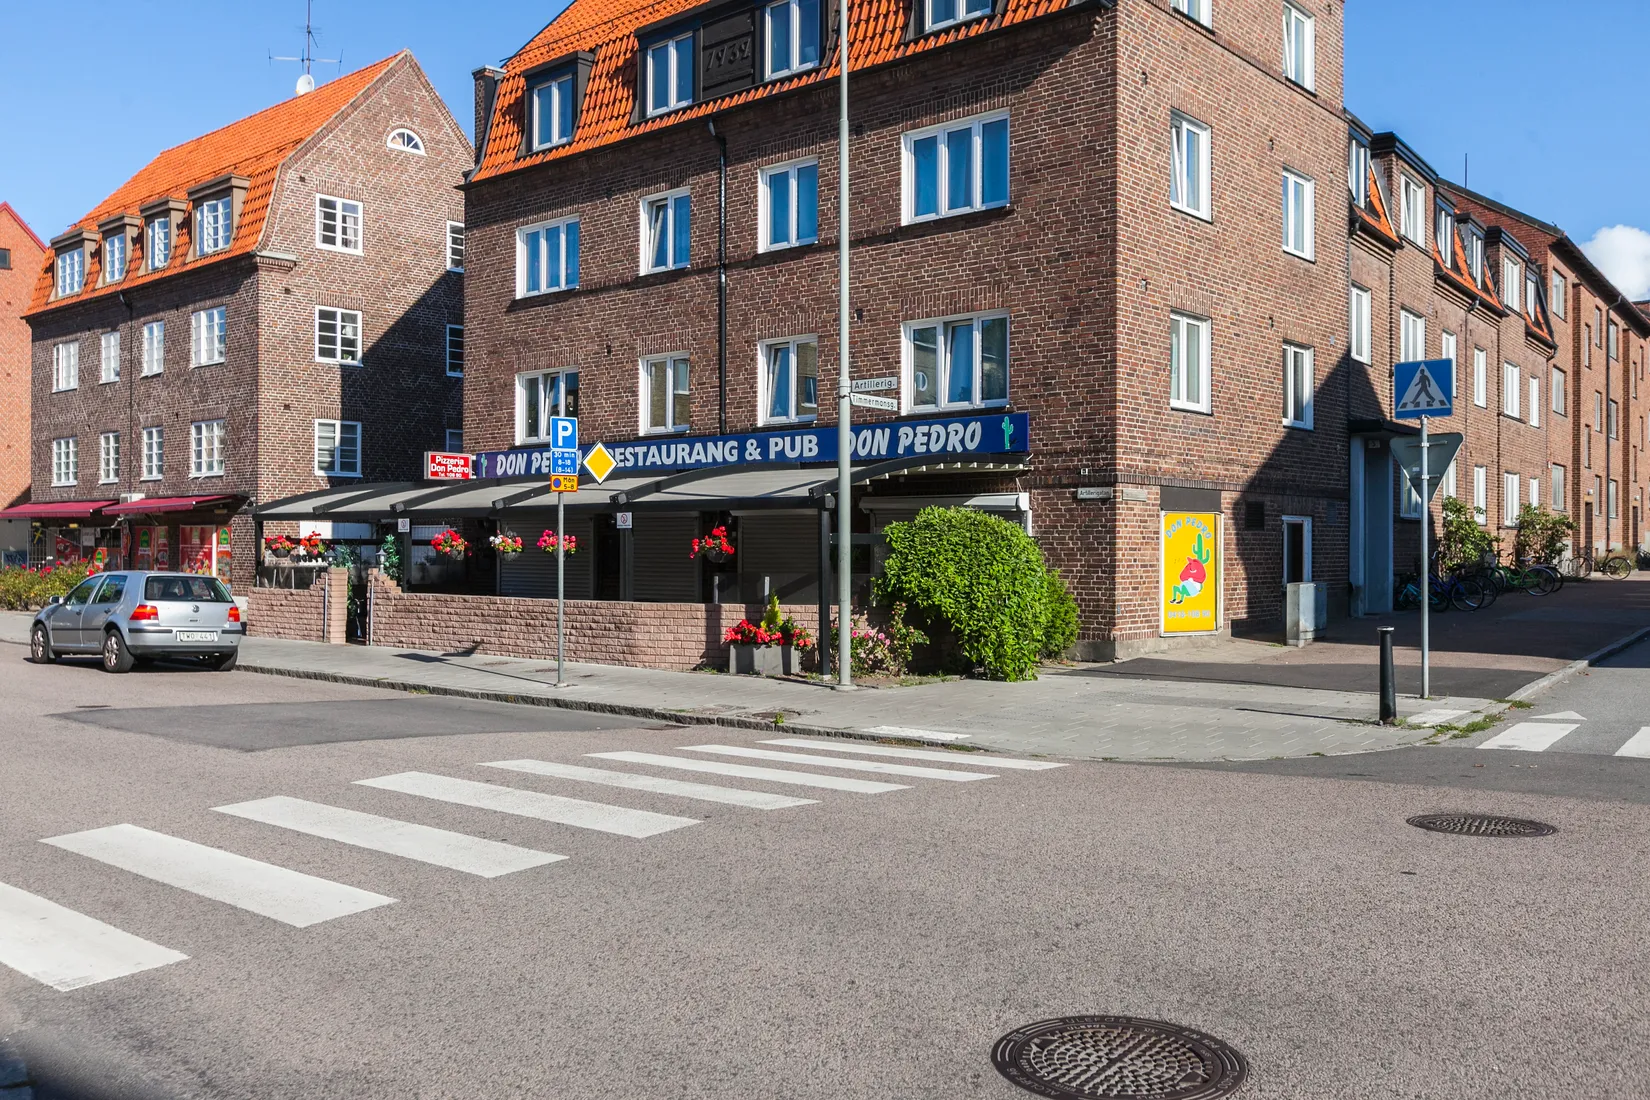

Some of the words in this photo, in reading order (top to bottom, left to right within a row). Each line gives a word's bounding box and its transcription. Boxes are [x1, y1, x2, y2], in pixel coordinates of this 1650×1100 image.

[854, 379, 895, 390] Artillerig.
[557, 420, 573, 447] P
[496, 452, 528, 476] DON
[607, 440, 739, 468] ESTAURANG
[744, 438, 762, 461] &
[769, 434, 819, 459] PUB
[897, 421, 982, 455] PEDRO
[435, 455, 464, 465] Pizzeria
[431, 463, 446, 472] Don
[447, 464, 469, 473] Pedro
[555, 466, 574, 474] (8-14)
[1164, 518, 1182, 539] DON
[1185, 515, 1212, 539] PEDRO
